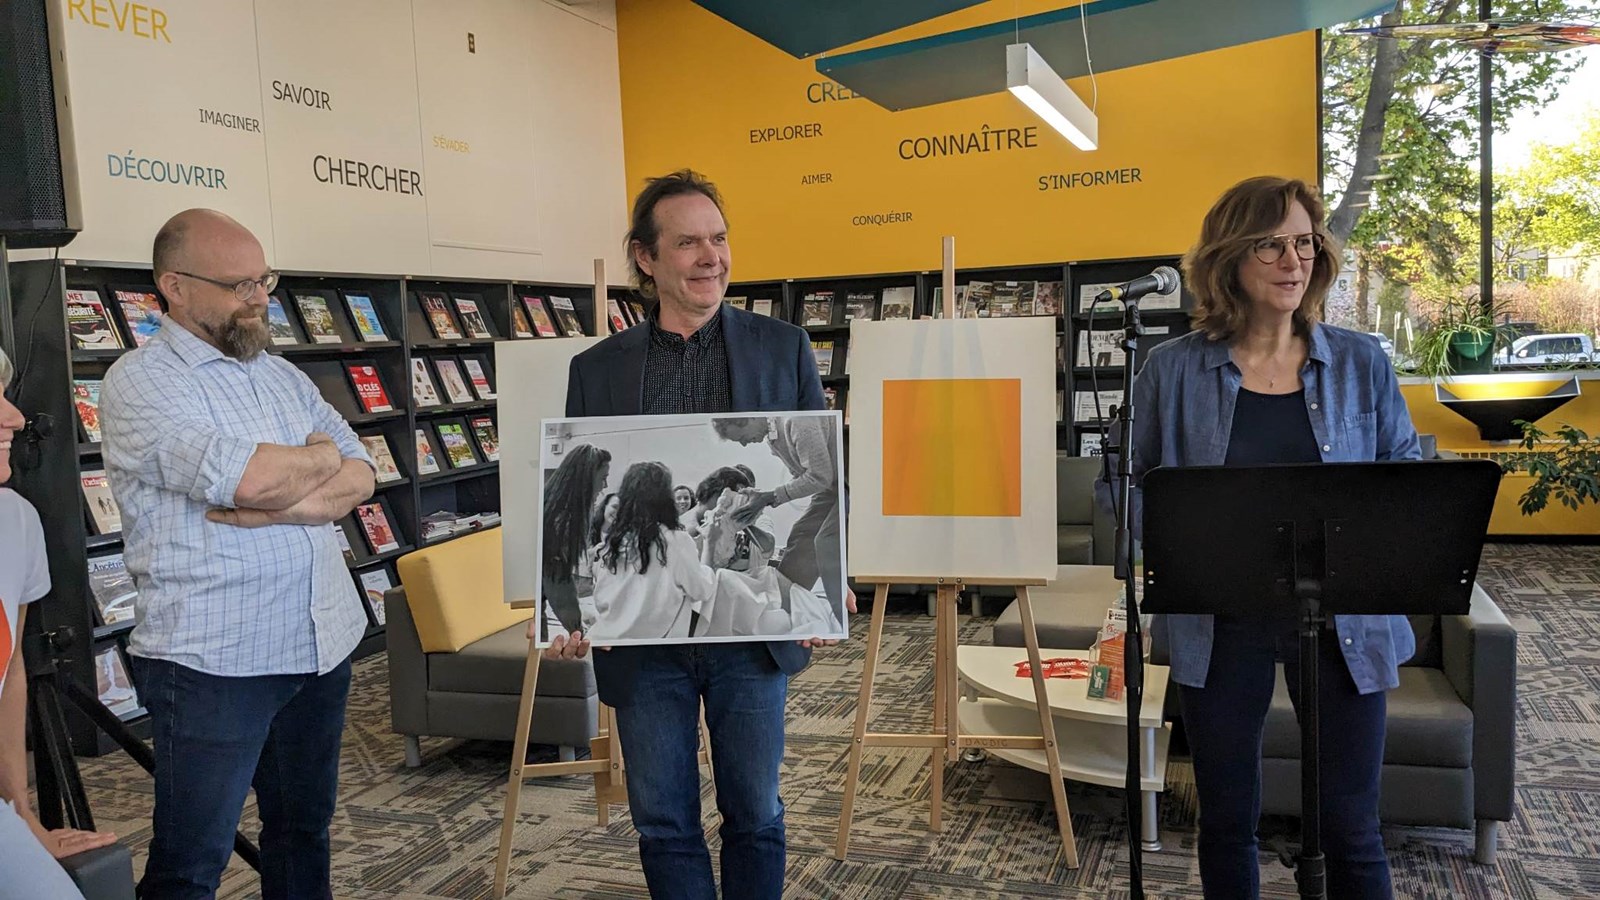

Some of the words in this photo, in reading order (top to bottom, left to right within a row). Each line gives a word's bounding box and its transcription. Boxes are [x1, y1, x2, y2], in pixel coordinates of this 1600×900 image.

[272, 80, 331, 110] SAVOIR
[199, 108, 260, 133] IMAGINER
[433, 135, 470, 153] S'ÉVADER
[750, 123, 822, 144] EXPLORER
[899, 124, 1037, 160] CONNAÎTRE
[107, 150, 227, 190] DÉCOUVRIR
[313, 155, 423, 196] CHERCHER
[801, 173, 833, 185] AIMER
[852, 211, 913, 227] CONQUÉRIR
